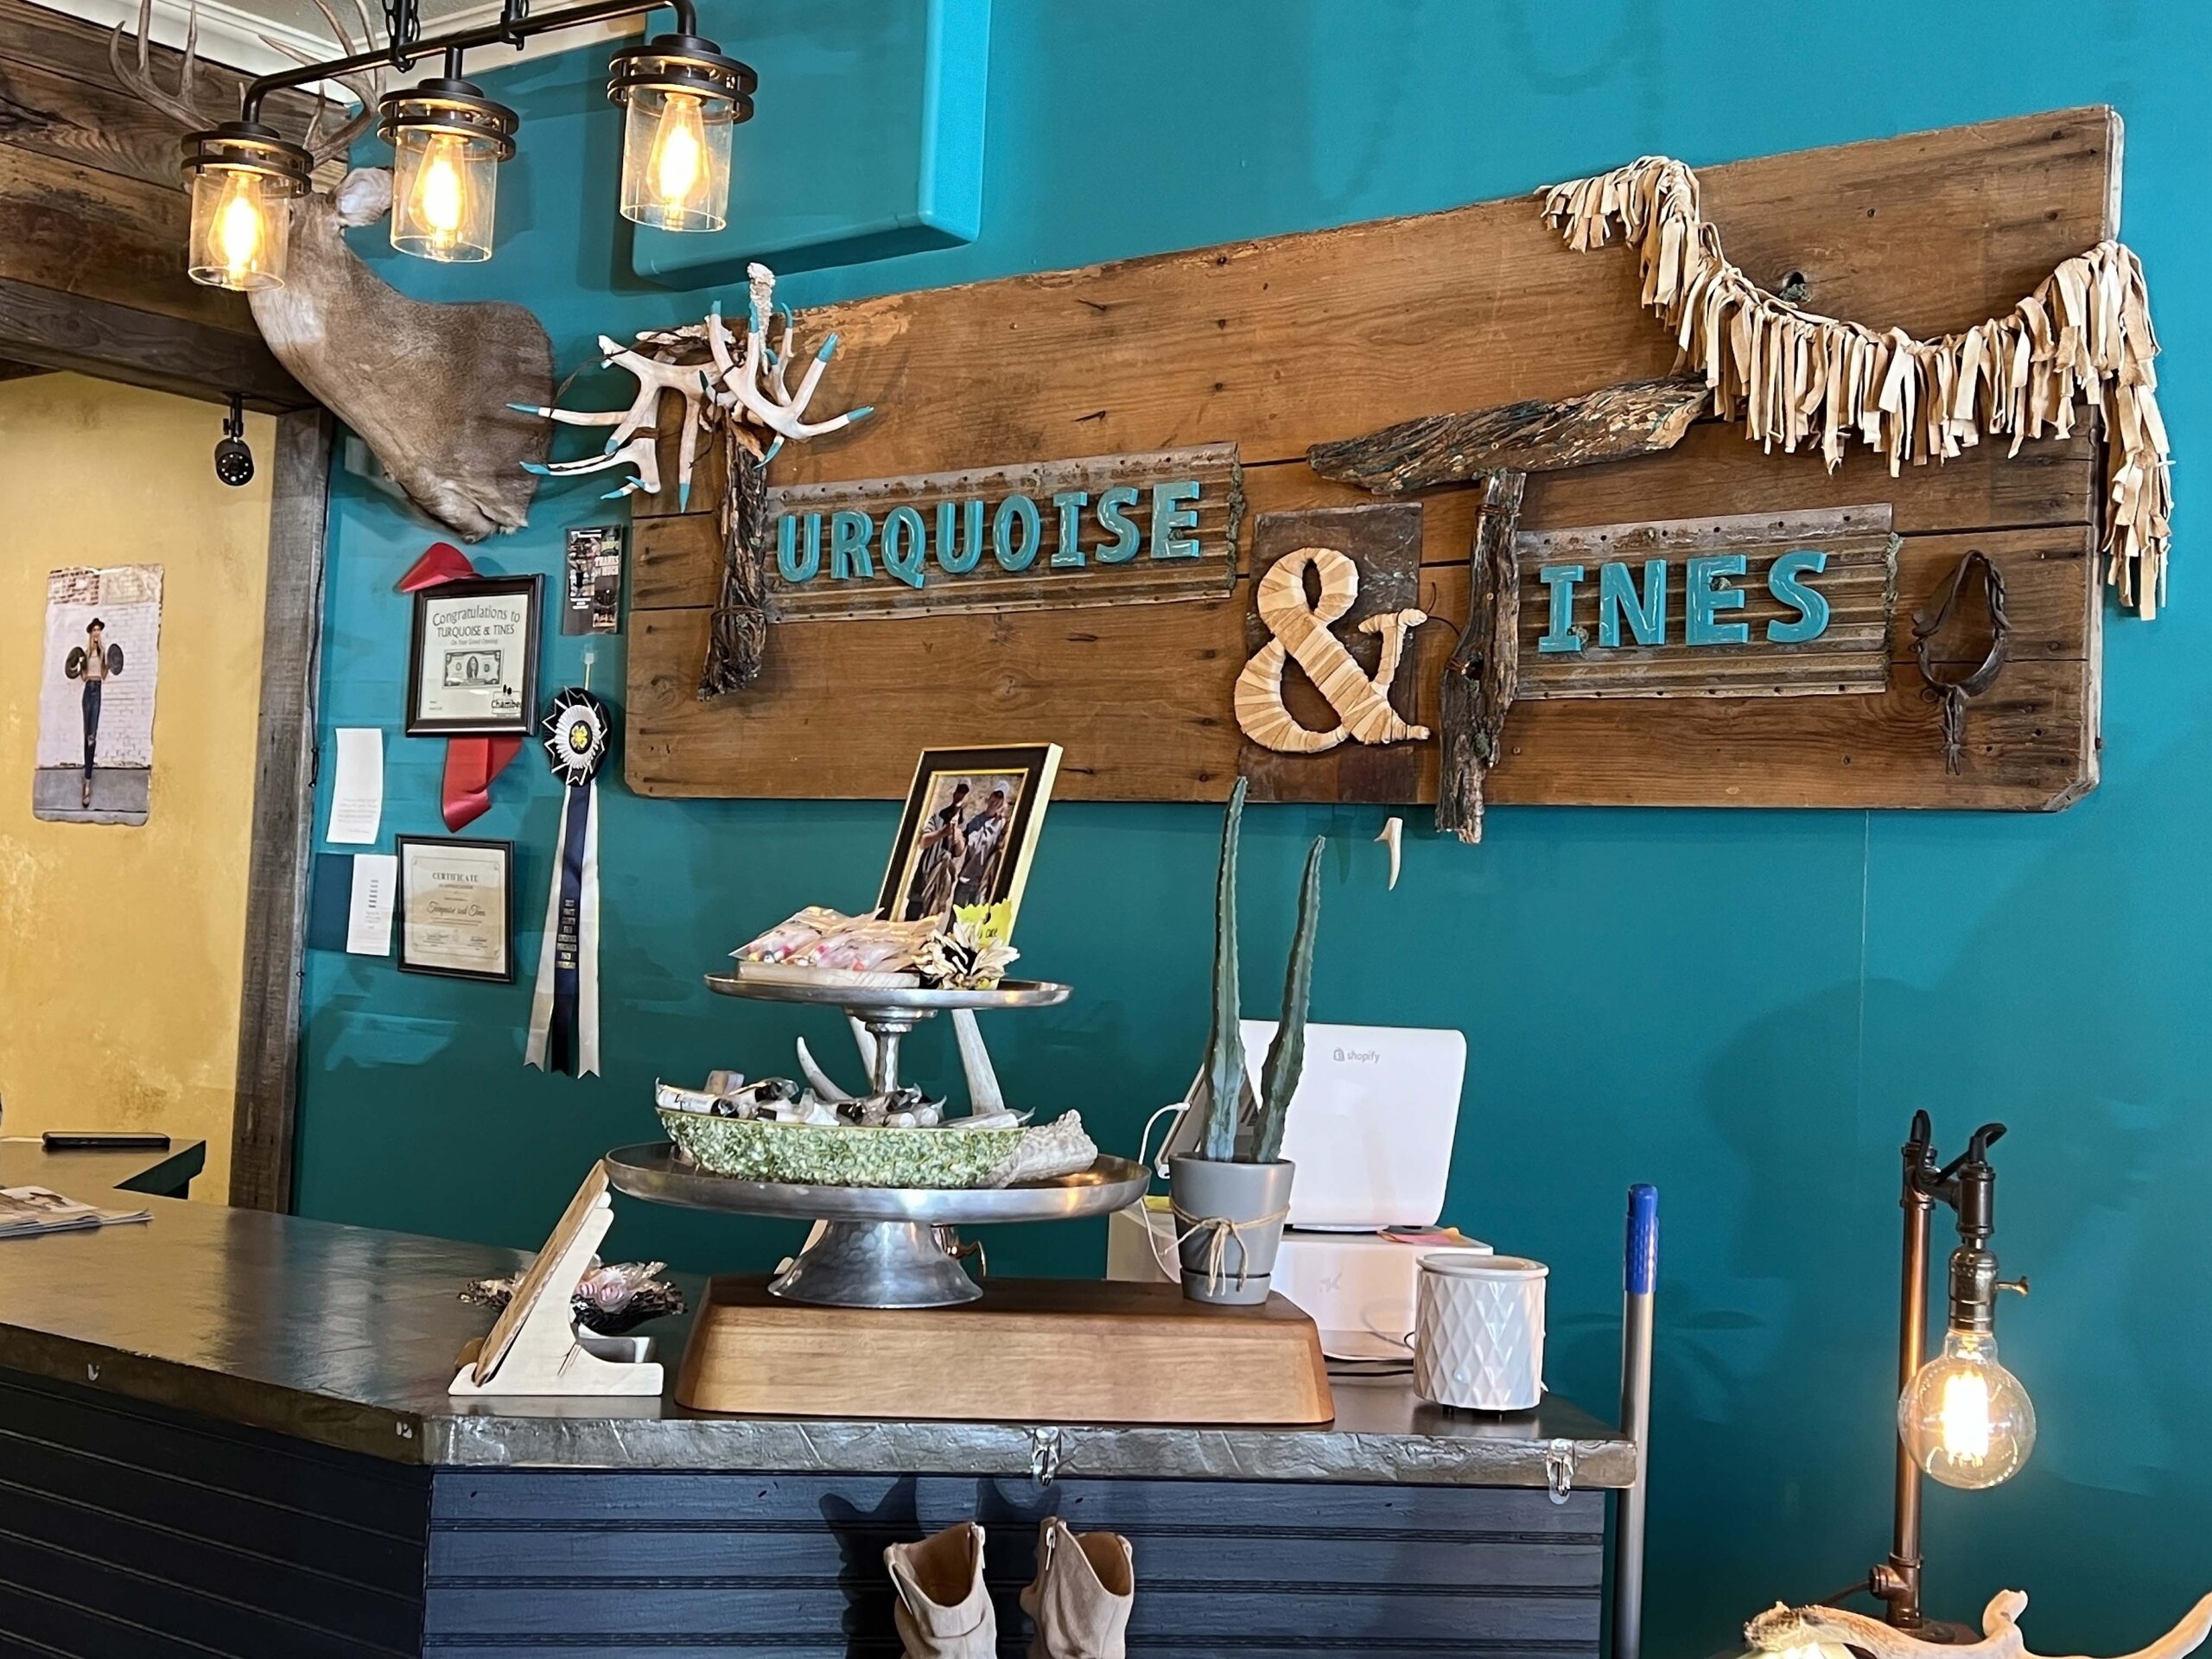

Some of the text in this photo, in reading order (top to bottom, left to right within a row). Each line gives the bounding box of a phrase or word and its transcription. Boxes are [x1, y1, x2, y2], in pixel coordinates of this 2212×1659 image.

[432, 605, 520, 626] Congratulations to
[438, 624, 515, 639] TURQUOISE & TINES
[1235, 547, 1431, 753] &
[432, 872, 479, 882] CERTIFICATE
[1347, 1050, 1380, 1064] shopify
